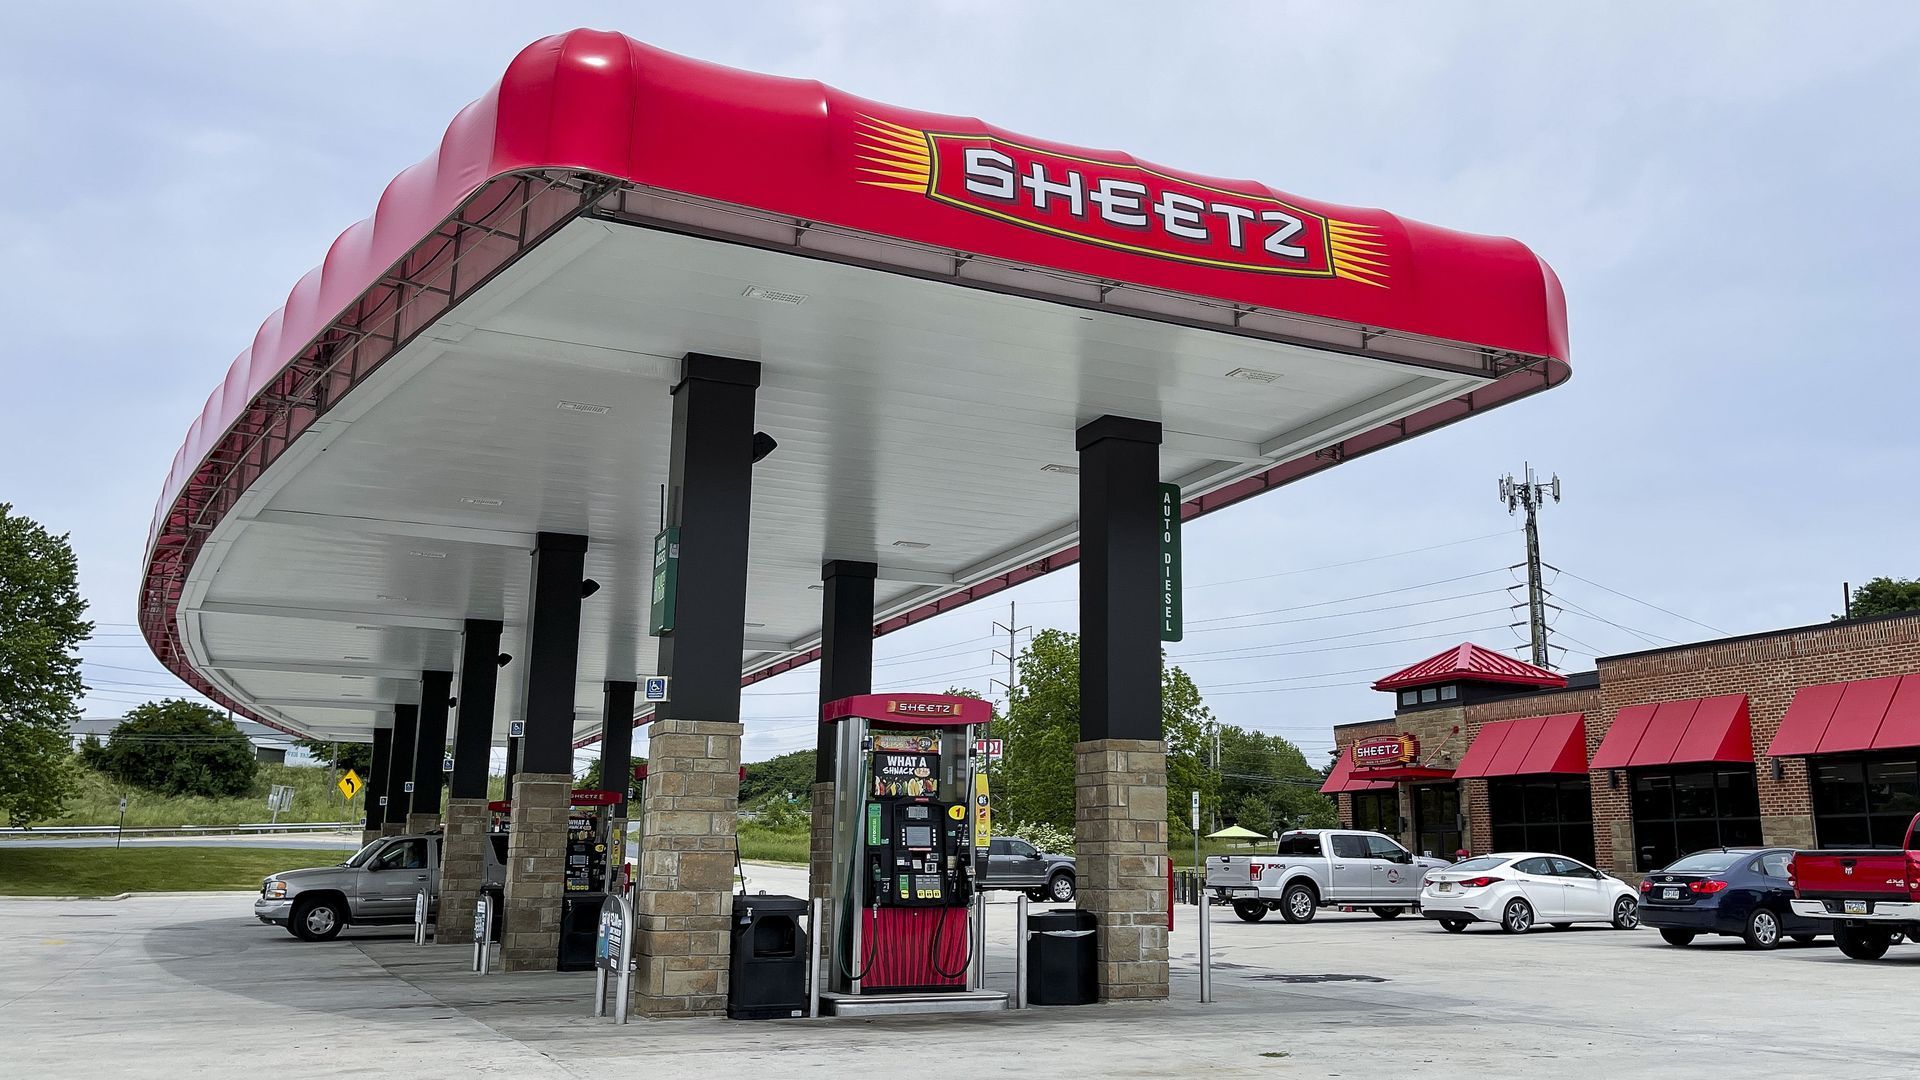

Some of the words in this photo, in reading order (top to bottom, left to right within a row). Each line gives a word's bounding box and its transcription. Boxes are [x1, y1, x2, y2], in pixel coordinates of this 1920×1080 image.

[965, 147, 1307, 258] SHEETZ
[1163, 492, 1171, 543] AUTO
[1164, 552, 1172, 632] DIESEL
[899, 703, 951, 713] SHEETZ
[1357, 744, 1399, 757] SHEETZ
[886, 755, 918, 768] WHAT
[918, 756, 928, 768] A
[954, 807, 962, 818] 1
